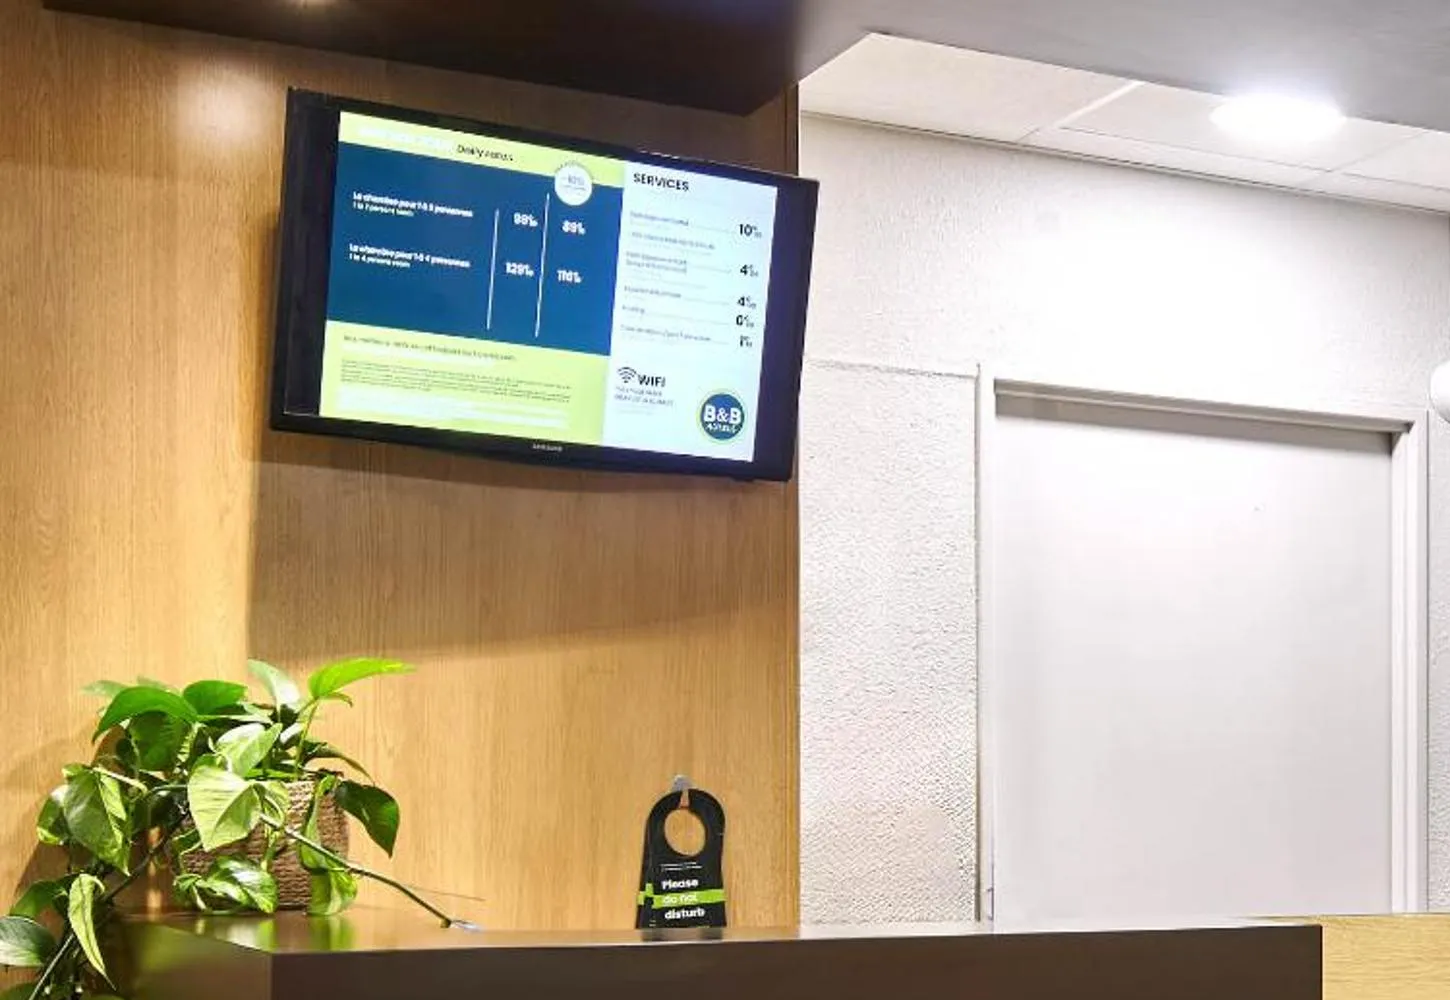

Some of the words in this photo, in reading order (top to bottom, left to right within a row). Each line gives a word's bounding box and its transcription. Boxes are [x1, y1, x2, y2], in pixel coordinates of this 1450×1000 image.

[633, 173, 690, 192] SERVICES
[637, 374, 666, 388] WIFI
[703, 404, 742, 425] B&B
[661, 879, 699, 890] Please
[664, 907, 706, 919] disturb
